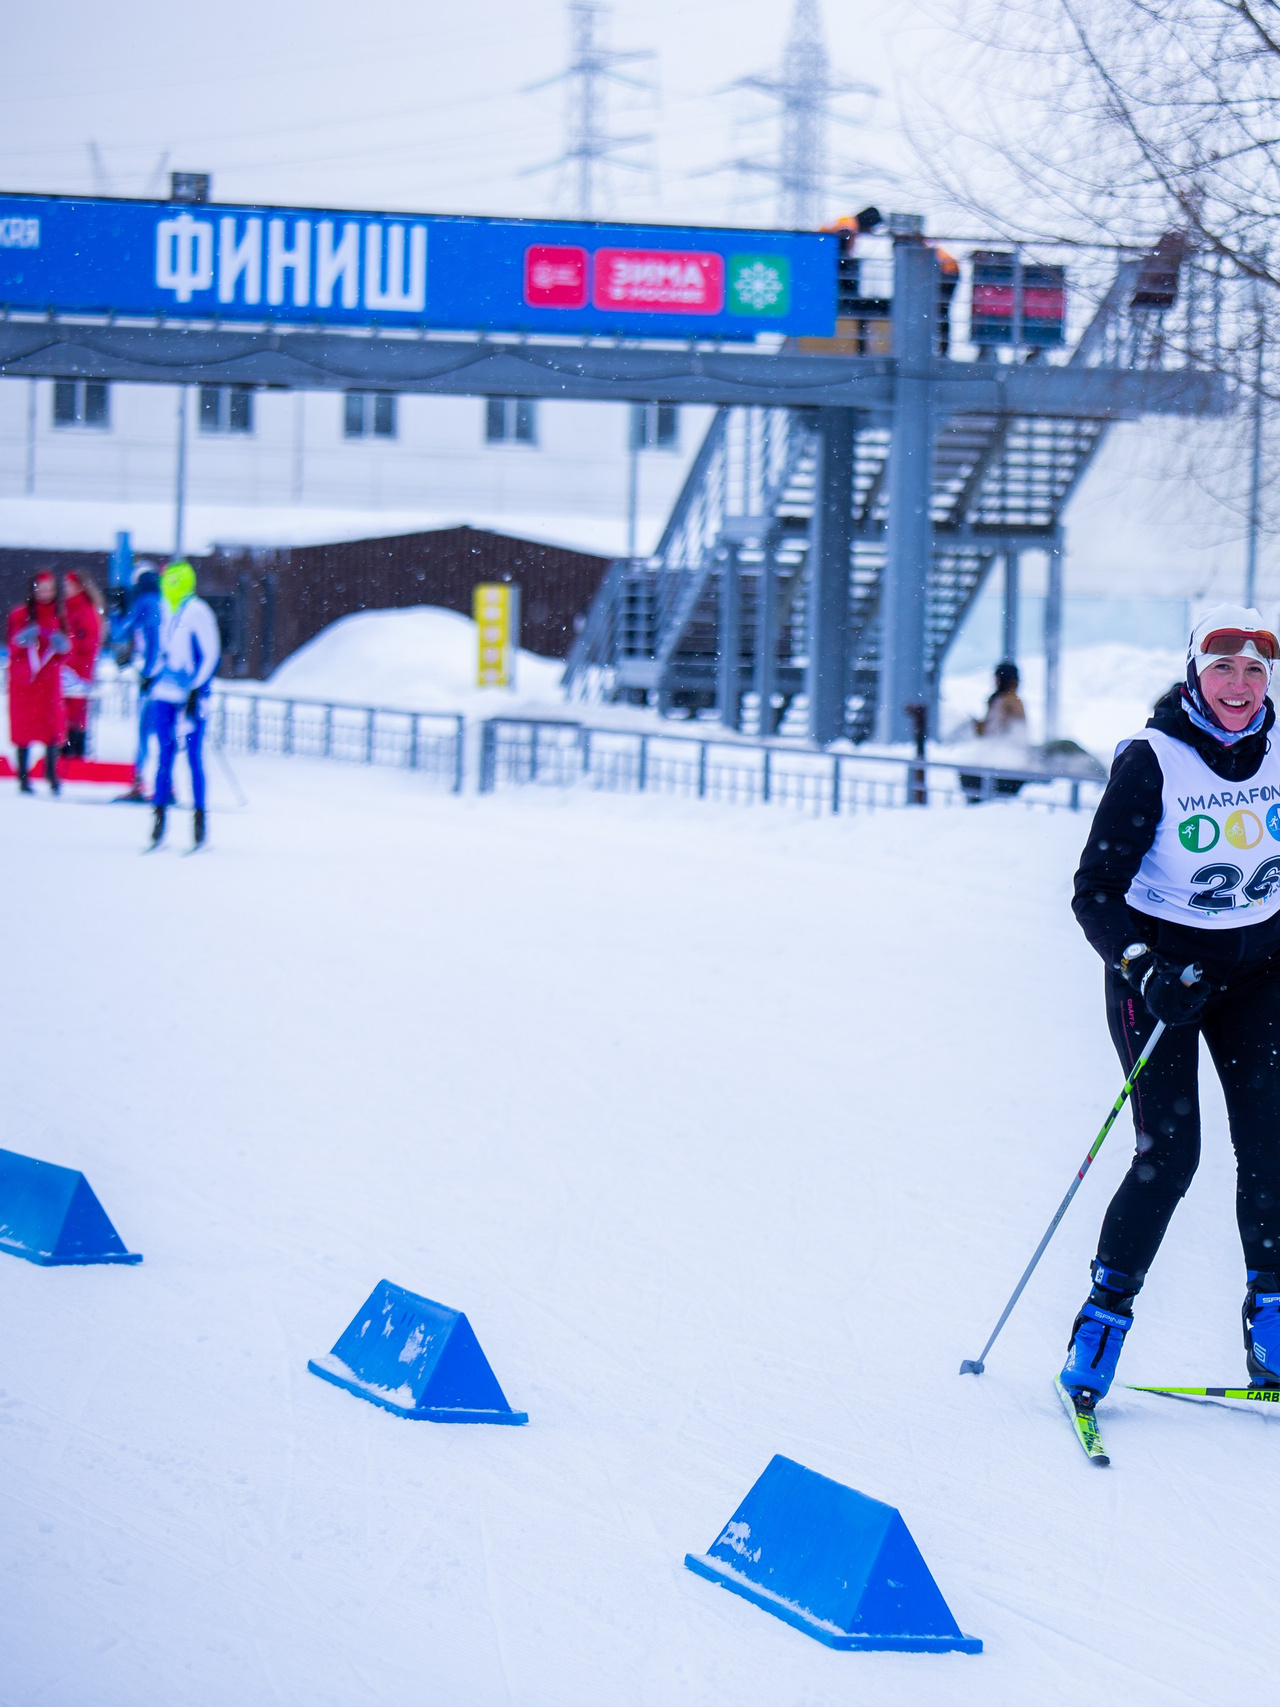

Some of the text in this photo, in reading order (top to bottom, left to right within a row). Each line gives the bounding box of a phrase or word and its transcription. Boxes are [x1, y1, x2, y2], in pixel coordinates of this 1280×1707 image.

[156, 213, 428, 313] ФИНИШ
[610, 258, 705, 288] ЗИМА
[1094, 1310, 1127, 1326] SPINE
